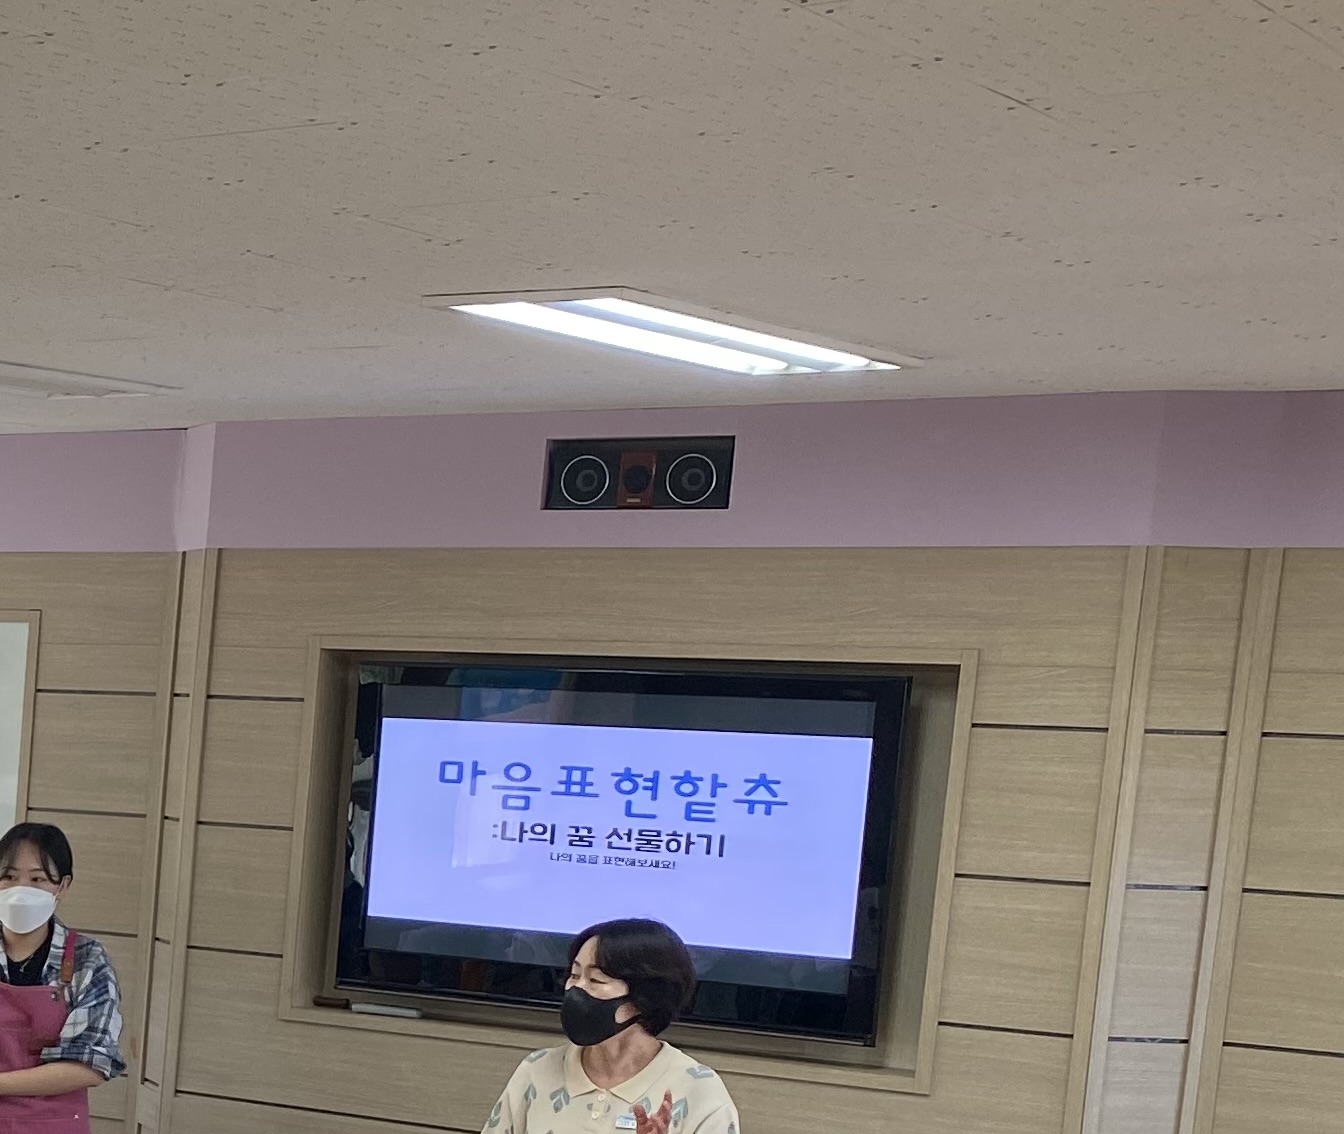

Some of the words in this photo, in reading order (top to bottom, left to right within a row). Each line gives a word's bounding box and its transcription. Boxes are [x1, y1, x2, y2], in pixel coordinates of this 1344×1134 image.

[567, 825, 595, 849] 꿈
[604, 827, 726, 858] 선물하기
[549, 852, 573, 863] 나의
